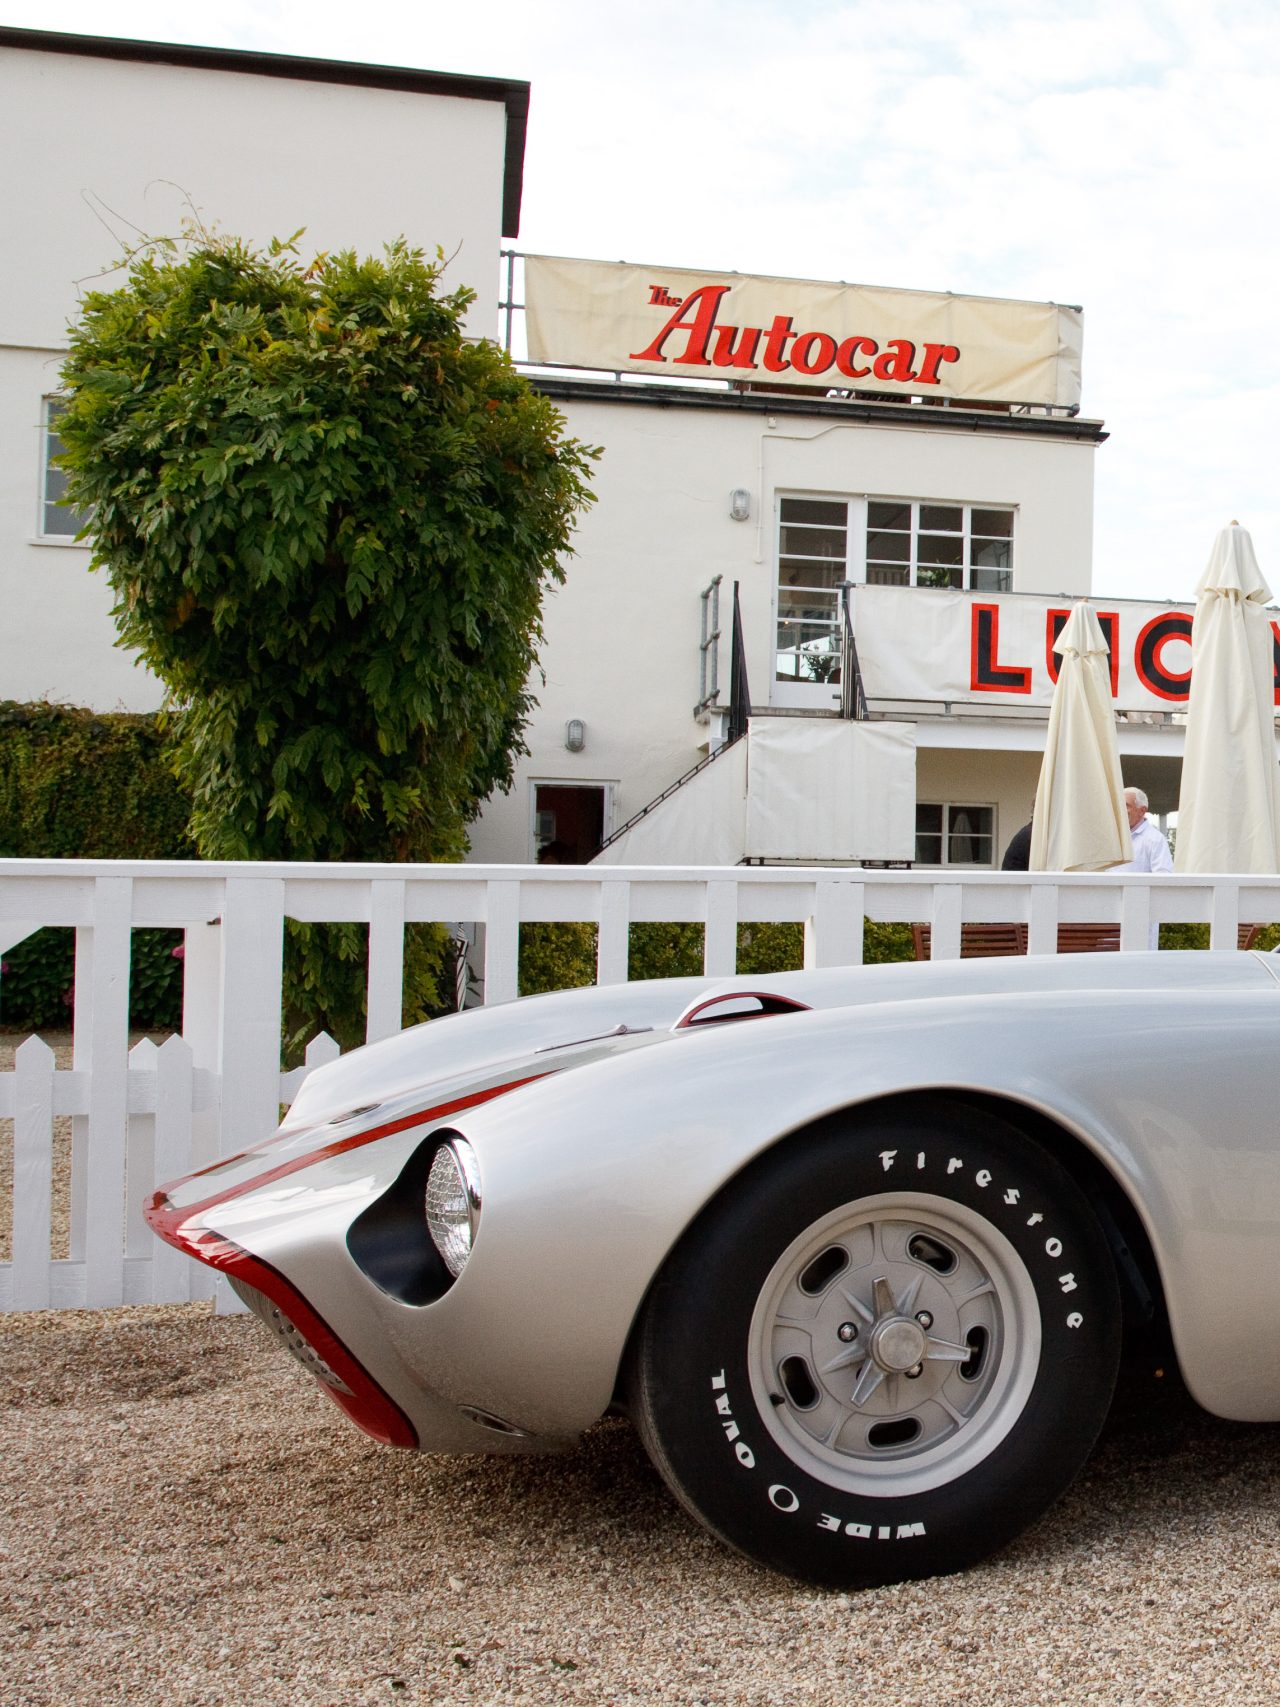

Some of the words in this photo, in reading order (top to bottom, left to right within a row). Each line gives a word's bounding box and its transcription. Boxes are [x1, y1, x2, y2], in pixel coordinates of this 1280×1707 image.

[647, 284, 683, 307] The
[628, 284, 961, 386] Autocar
[710, 1367, 757, 1469] OVAL
[816, 1513, 927, 1541] WIDE
